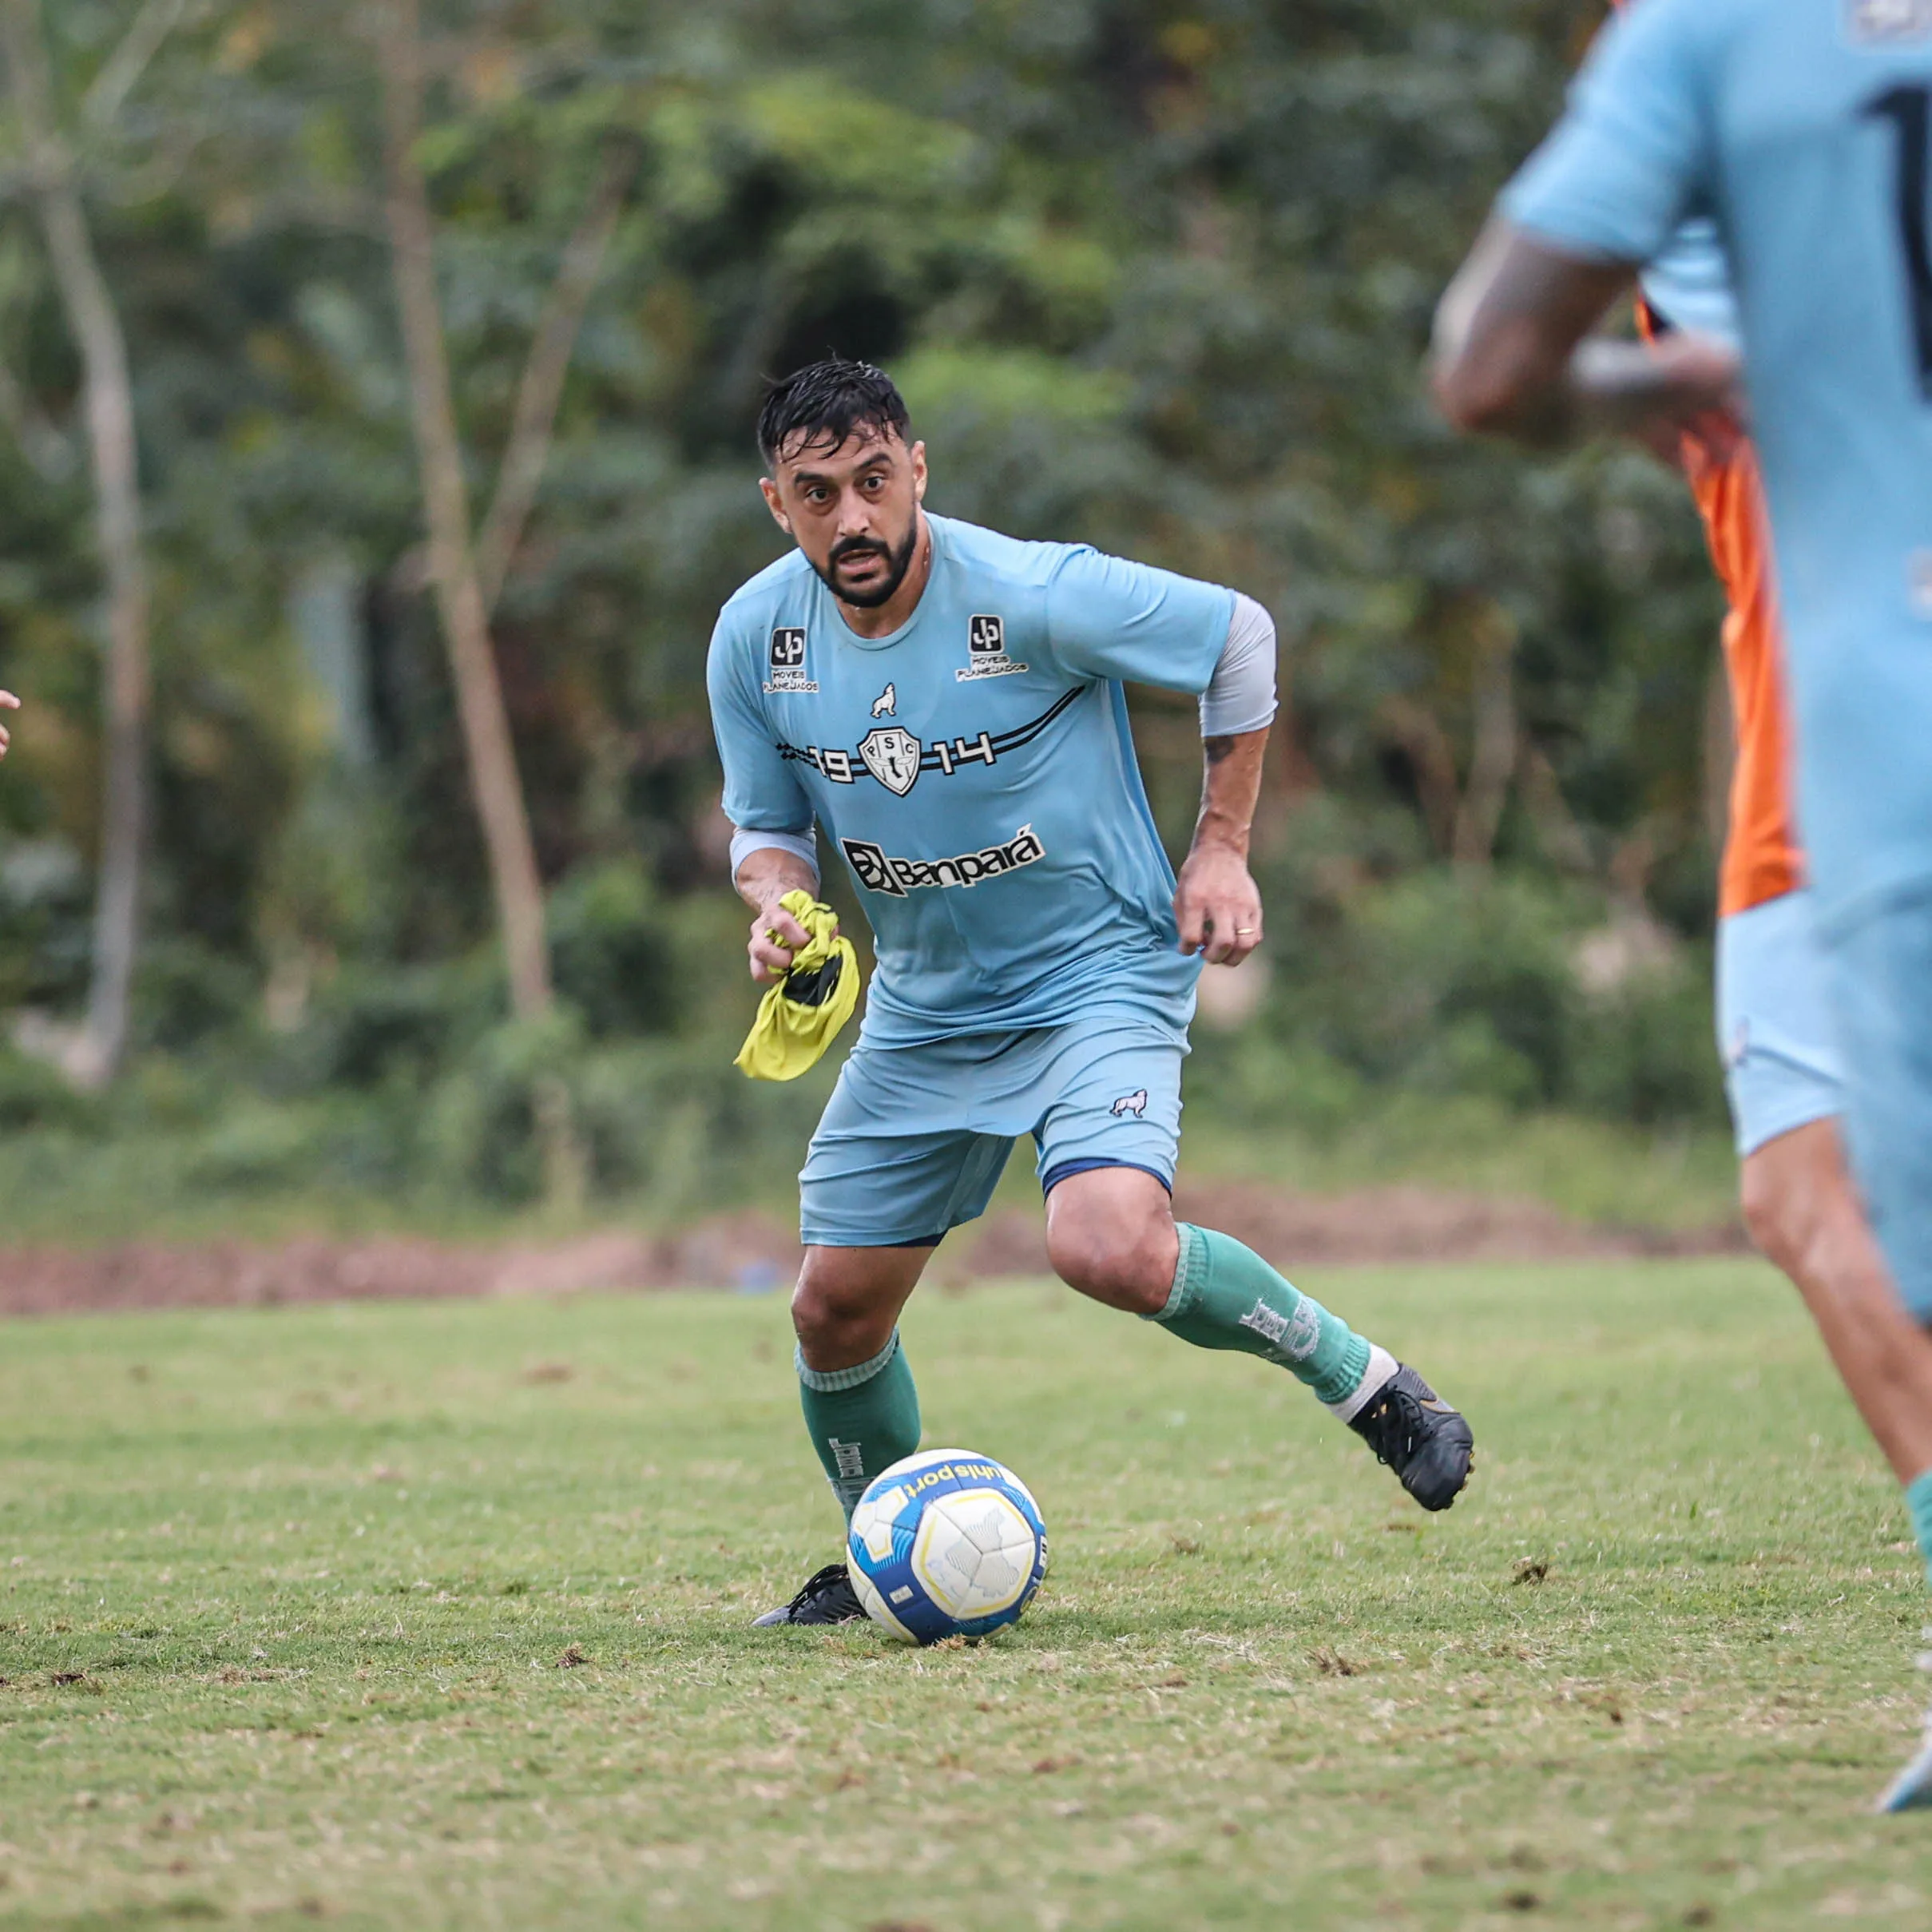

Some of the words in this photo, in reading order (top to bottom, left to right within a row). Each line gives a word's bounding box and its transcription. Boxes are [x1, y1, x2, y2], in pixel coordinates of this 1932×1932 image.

[808, 745, 856, 784] 19
[931, 730, 998, 776] 14
[889, 829, 1042, 886] Banpará
[903, 1463, 1002, 1498] uhlsport
